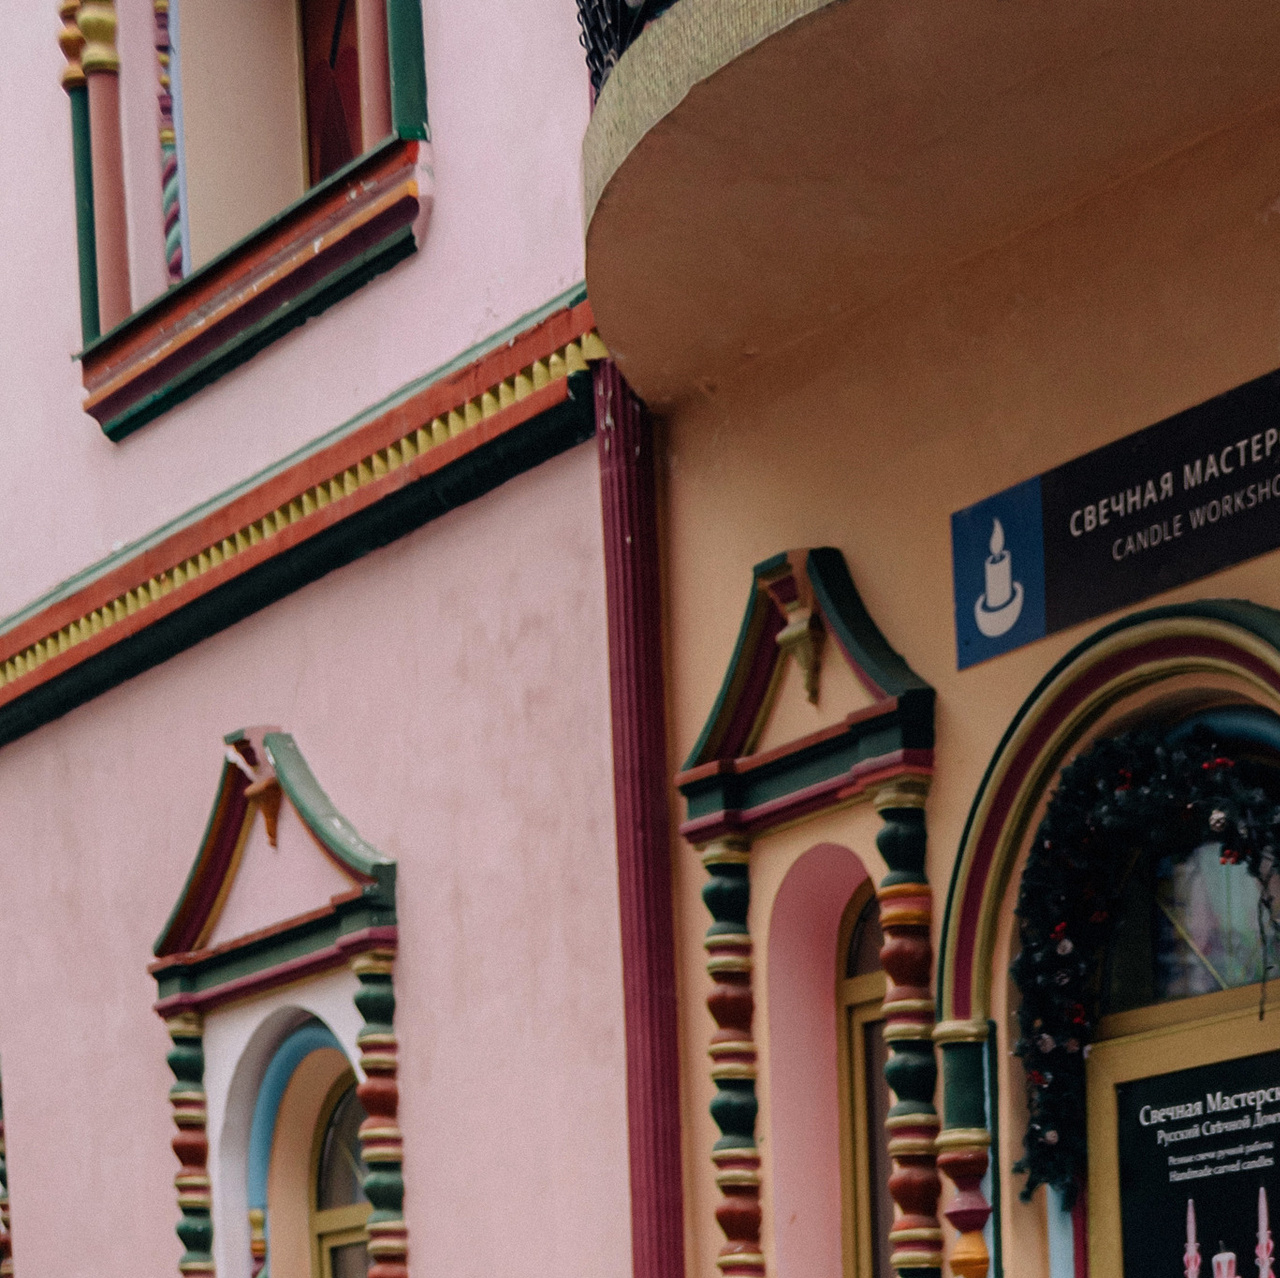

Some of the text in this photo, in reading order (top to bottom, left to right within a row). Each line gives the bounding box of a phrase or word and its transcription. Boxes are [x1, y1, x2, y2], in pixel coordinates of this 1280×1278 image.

[1069, 472, 1174, 538] СВЕЧНАЯ
[1111, 513, 1183, 562] CANDLE
[1139, 1101, 1203, 1126] Свечная
[1157, 1124, 1201, 1147] Русский
[1215, 1143, 1244, 1160] ручной
[1244, 1140, 1275, 1155] работы
[1169, 1155, 1275, 1182] Handmade carved candles
